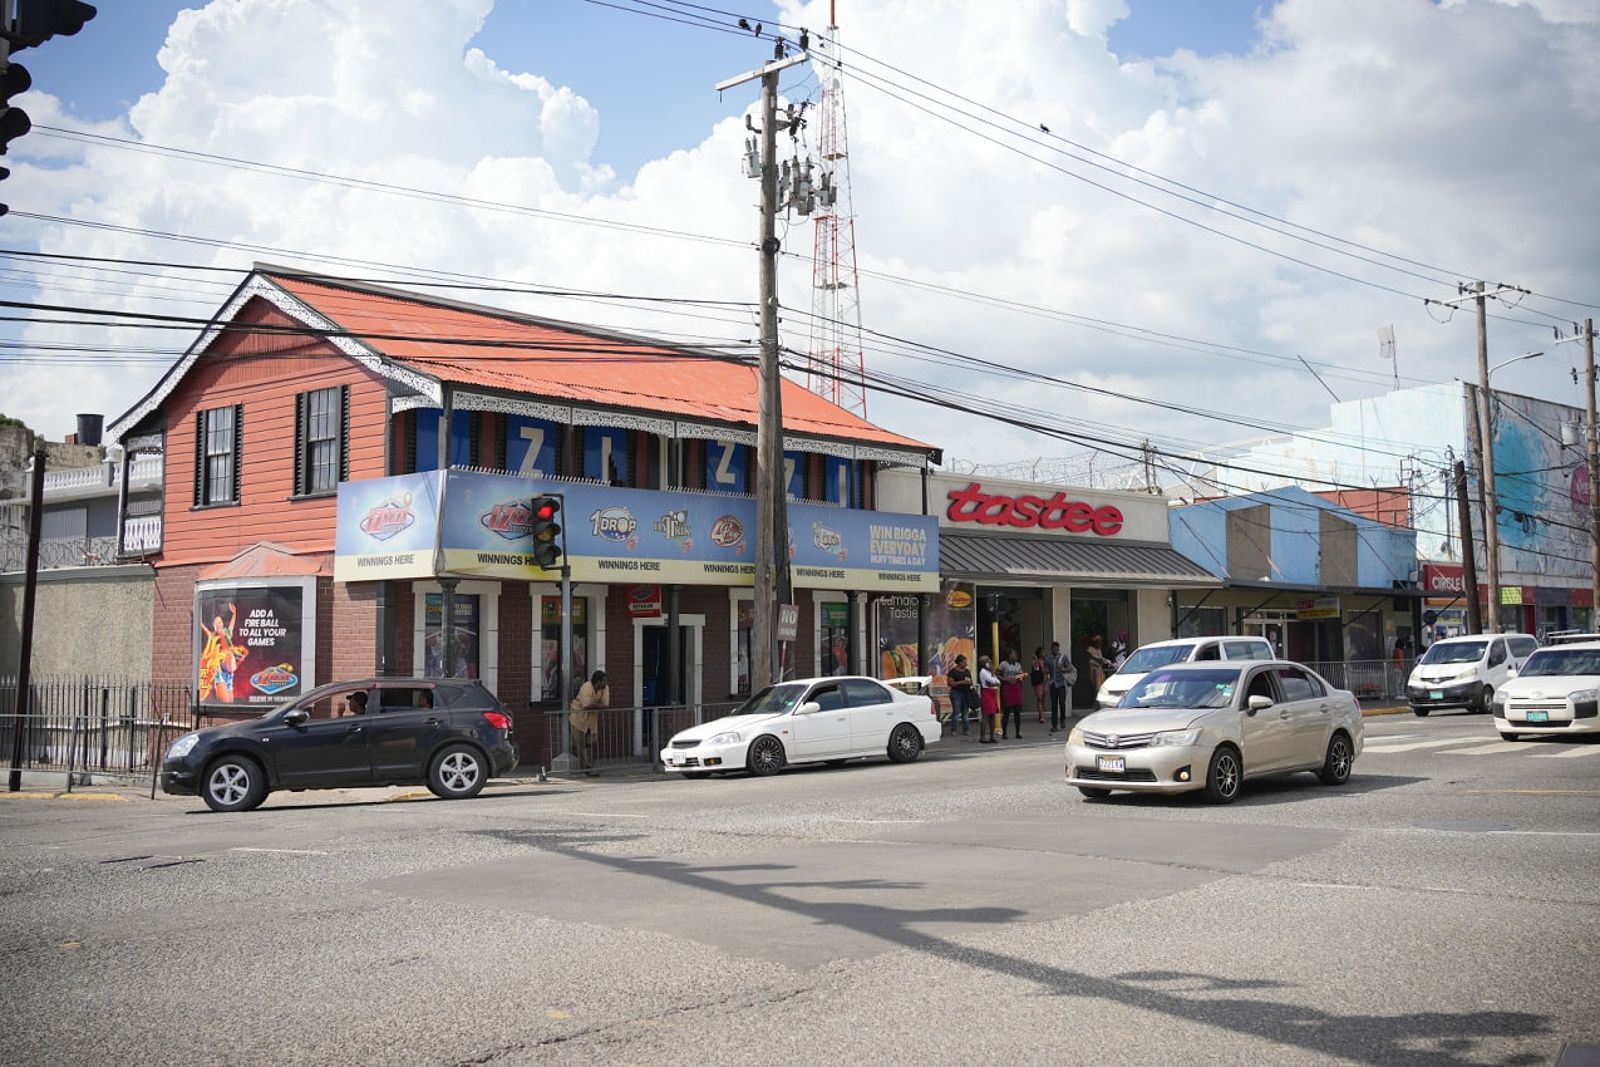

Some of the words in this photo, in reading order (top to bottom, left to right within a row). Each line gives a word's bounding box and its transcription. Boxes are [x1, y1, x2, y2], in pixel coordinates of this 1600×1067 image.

[947, 482, 1124, 536] tastee
[870, 525, 893, 540] WIN
[894, 526, 926, 542] BIGGA
[870, 539, 926, 557] EVERYDAY
[357, 556, 393, 568] WINNINGS
[394, 554, 415, 566] HERE
[477, 553, 523, 566] WINNINGS
[598, 560, 638, 571] WINNINGS
[640, 561, 661, 571] HERE
[703, 563, 739, 574] WINNINGS
[796, 567, 828, 578] WINNINGS
[829, 570, 846, 579] HERE
[249, 609, 267, 618] ADD
[267, 609, 274, 618] A
[781, 609, 798, 625] NO
[239, 628, 249, 637] TO
[249, 628, 262, 637] ALL
[263, 628, 287, 637] YOUR
[247, 637, 276, 646] GAMES
